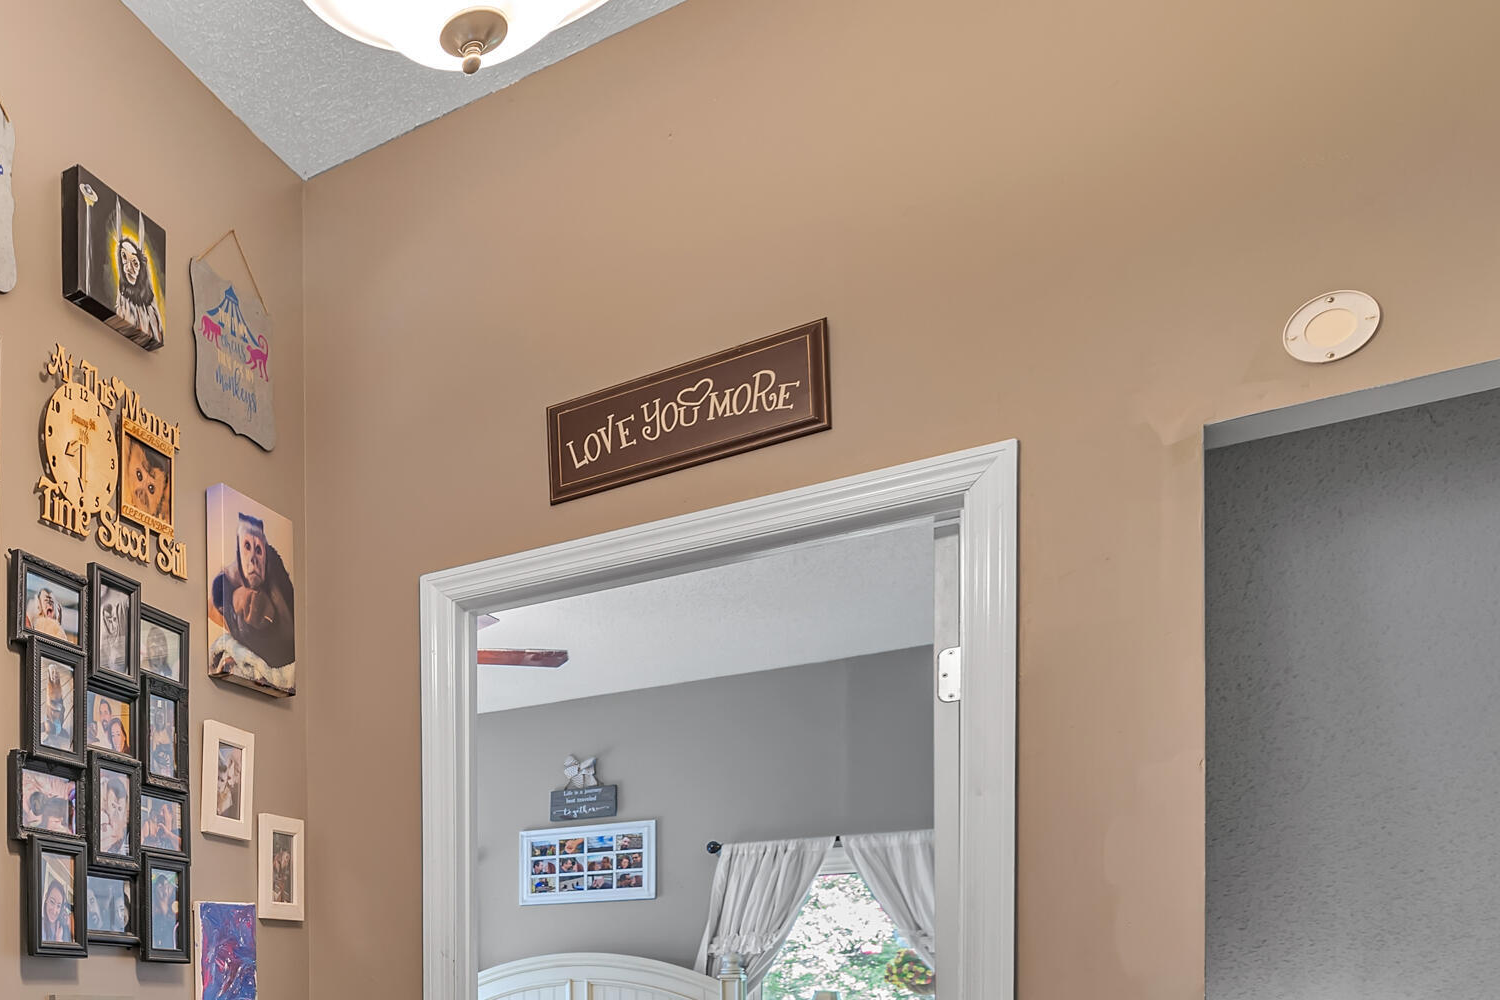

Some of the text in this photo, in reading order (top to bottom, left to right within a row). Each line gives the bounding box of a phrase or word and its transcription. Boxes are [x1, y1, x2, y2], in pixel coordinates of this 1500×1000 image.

[48, 343, 181, 451] At This Moment
[64, 386, 72, 400] 11
[79, 387, 89, 402] 12
[51, 399, 61, 413] 10
[96, 405, 101, 417] 1
[566, 369, 800, 469] LOVE YOU MORE
[47, 425, 53, 437] 9
[107, 430, 112, 442] 2
[52, 456, 57, 467] 8
[110, 458, 115, 470] 3
[63, 481, 69, 492] 7
[106, 482, 112, 494] 4
[78, 496, 84, 508] 6
[94, 496, 100, 508] 5
[38, 475, 188, 580] Time Stood Still
